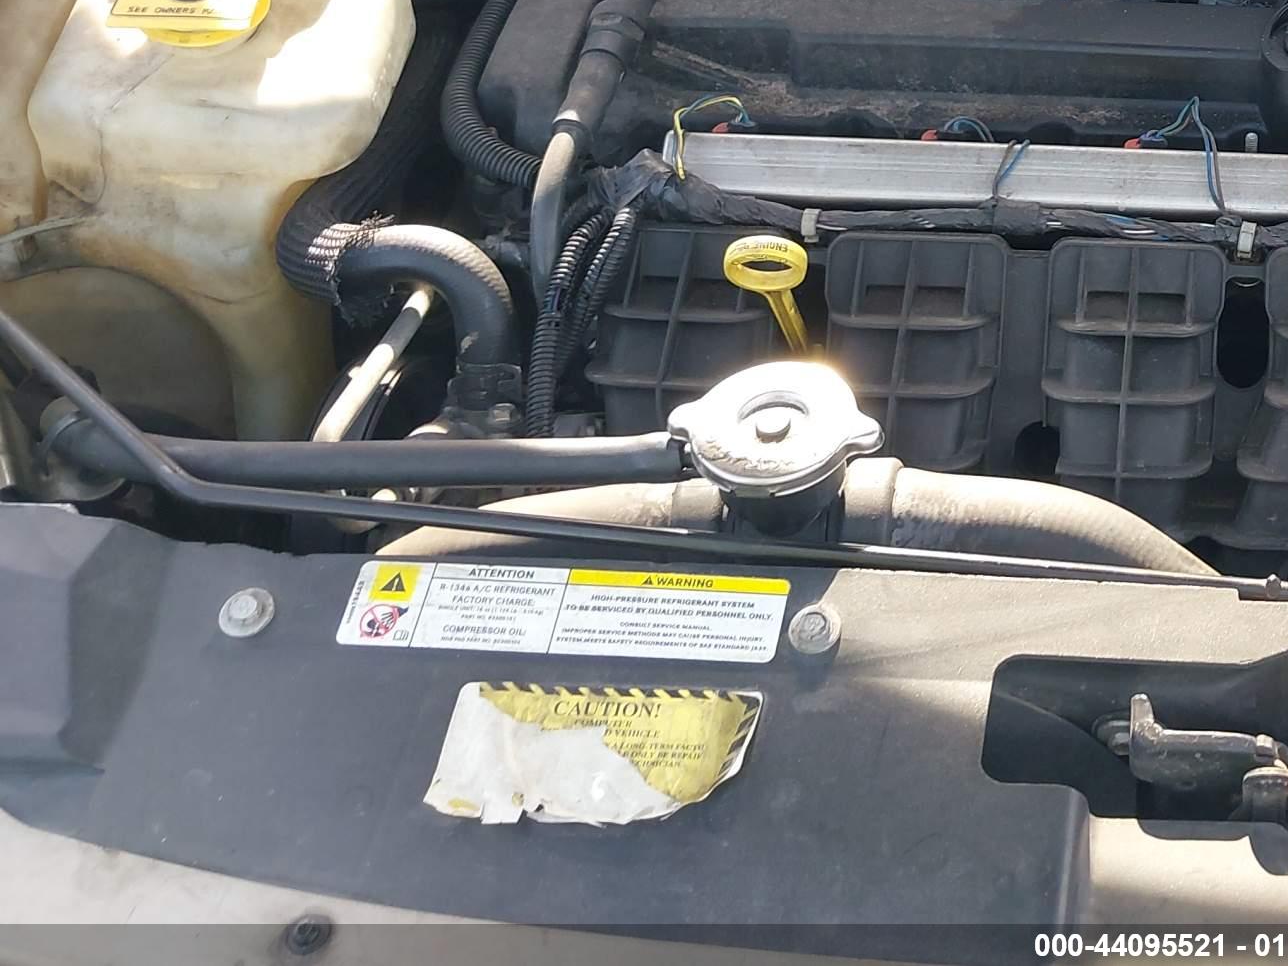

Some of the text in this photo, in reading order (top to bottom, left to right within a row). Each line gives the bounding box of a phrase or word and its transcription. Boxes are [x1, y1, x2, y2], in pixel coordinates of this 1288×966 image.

[468, 568, 535, 579] ATTENTION
[657, 577, 714, 588] WARNING
[473, 584, 491, 593] A/C
[494, 585, 556, 596] REFRIGERANT
[452, 595, 536, 607] FACTORY CHARGE:
[591, 594, 755, 609] HIGH-PRESSURE REFRIGERANT SYSTEM
[591, 605, 634, 613] SERVICED
[648, 608, 694, 616] QUALIFIED
[696, 610, 747, 619] PERSONNEL
[442, 624, 507, 635] COMPRESSOR
[554, 700, 662, 719] CAUTION!
[615, 729, 661, 738] VEHICLE
